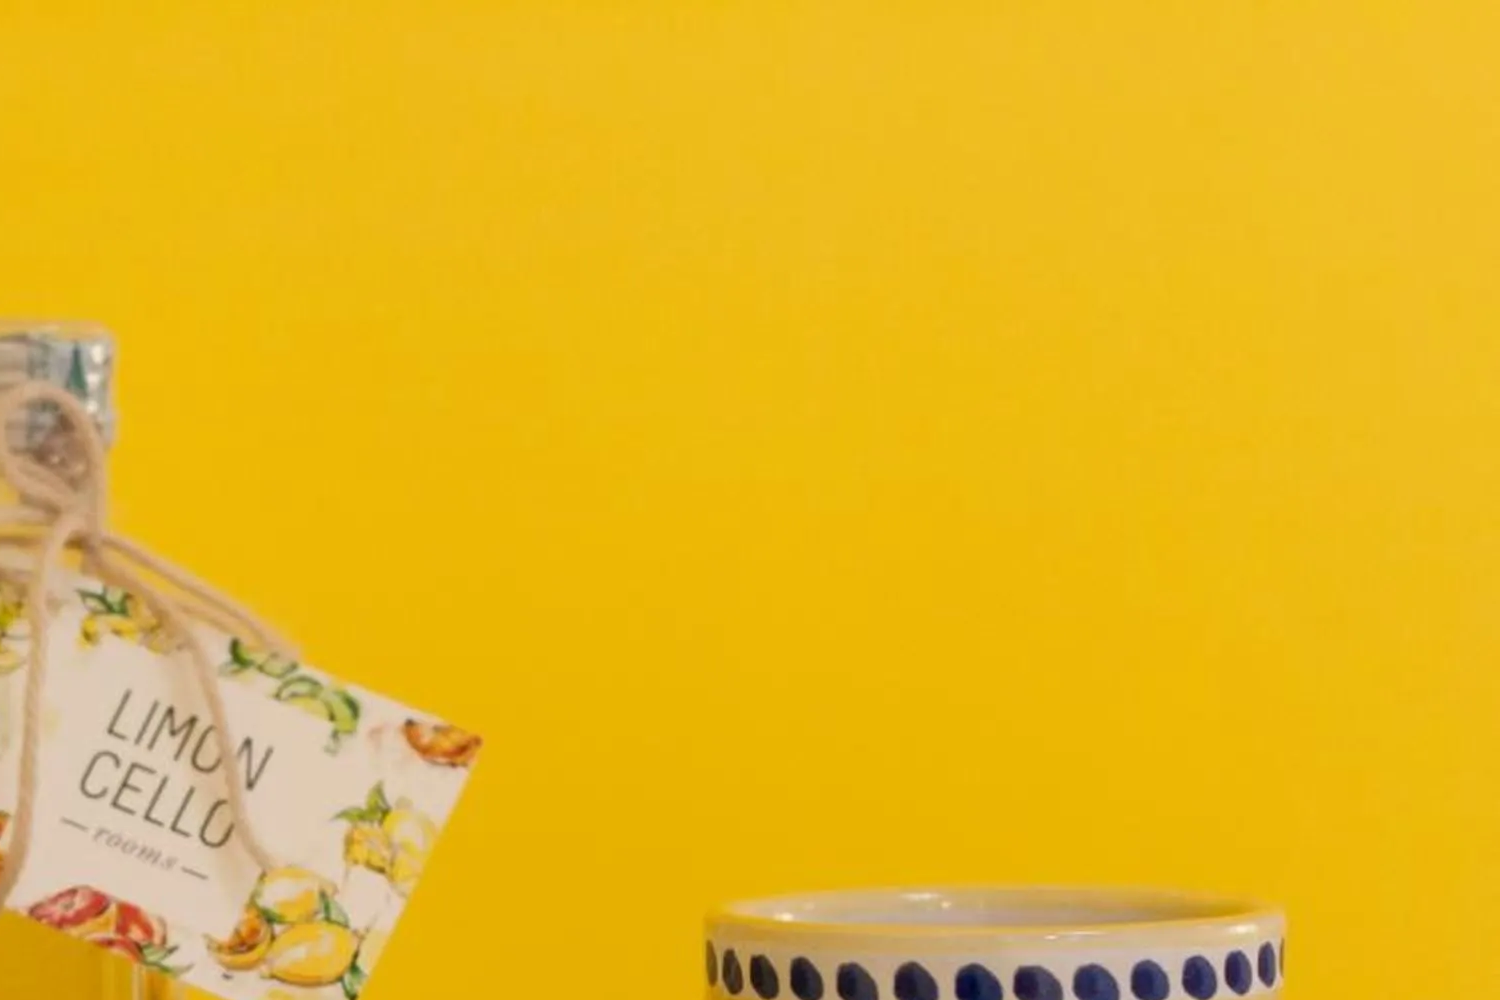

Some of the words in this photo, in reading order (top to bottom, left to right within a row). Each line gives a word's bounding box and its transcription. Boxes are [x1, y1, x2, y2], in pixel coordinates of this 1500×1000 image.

[106, 688, 274, 791] LIMON
[78, 750, 235, 849] CELLO
[92, 826, 179, 871] rooms
